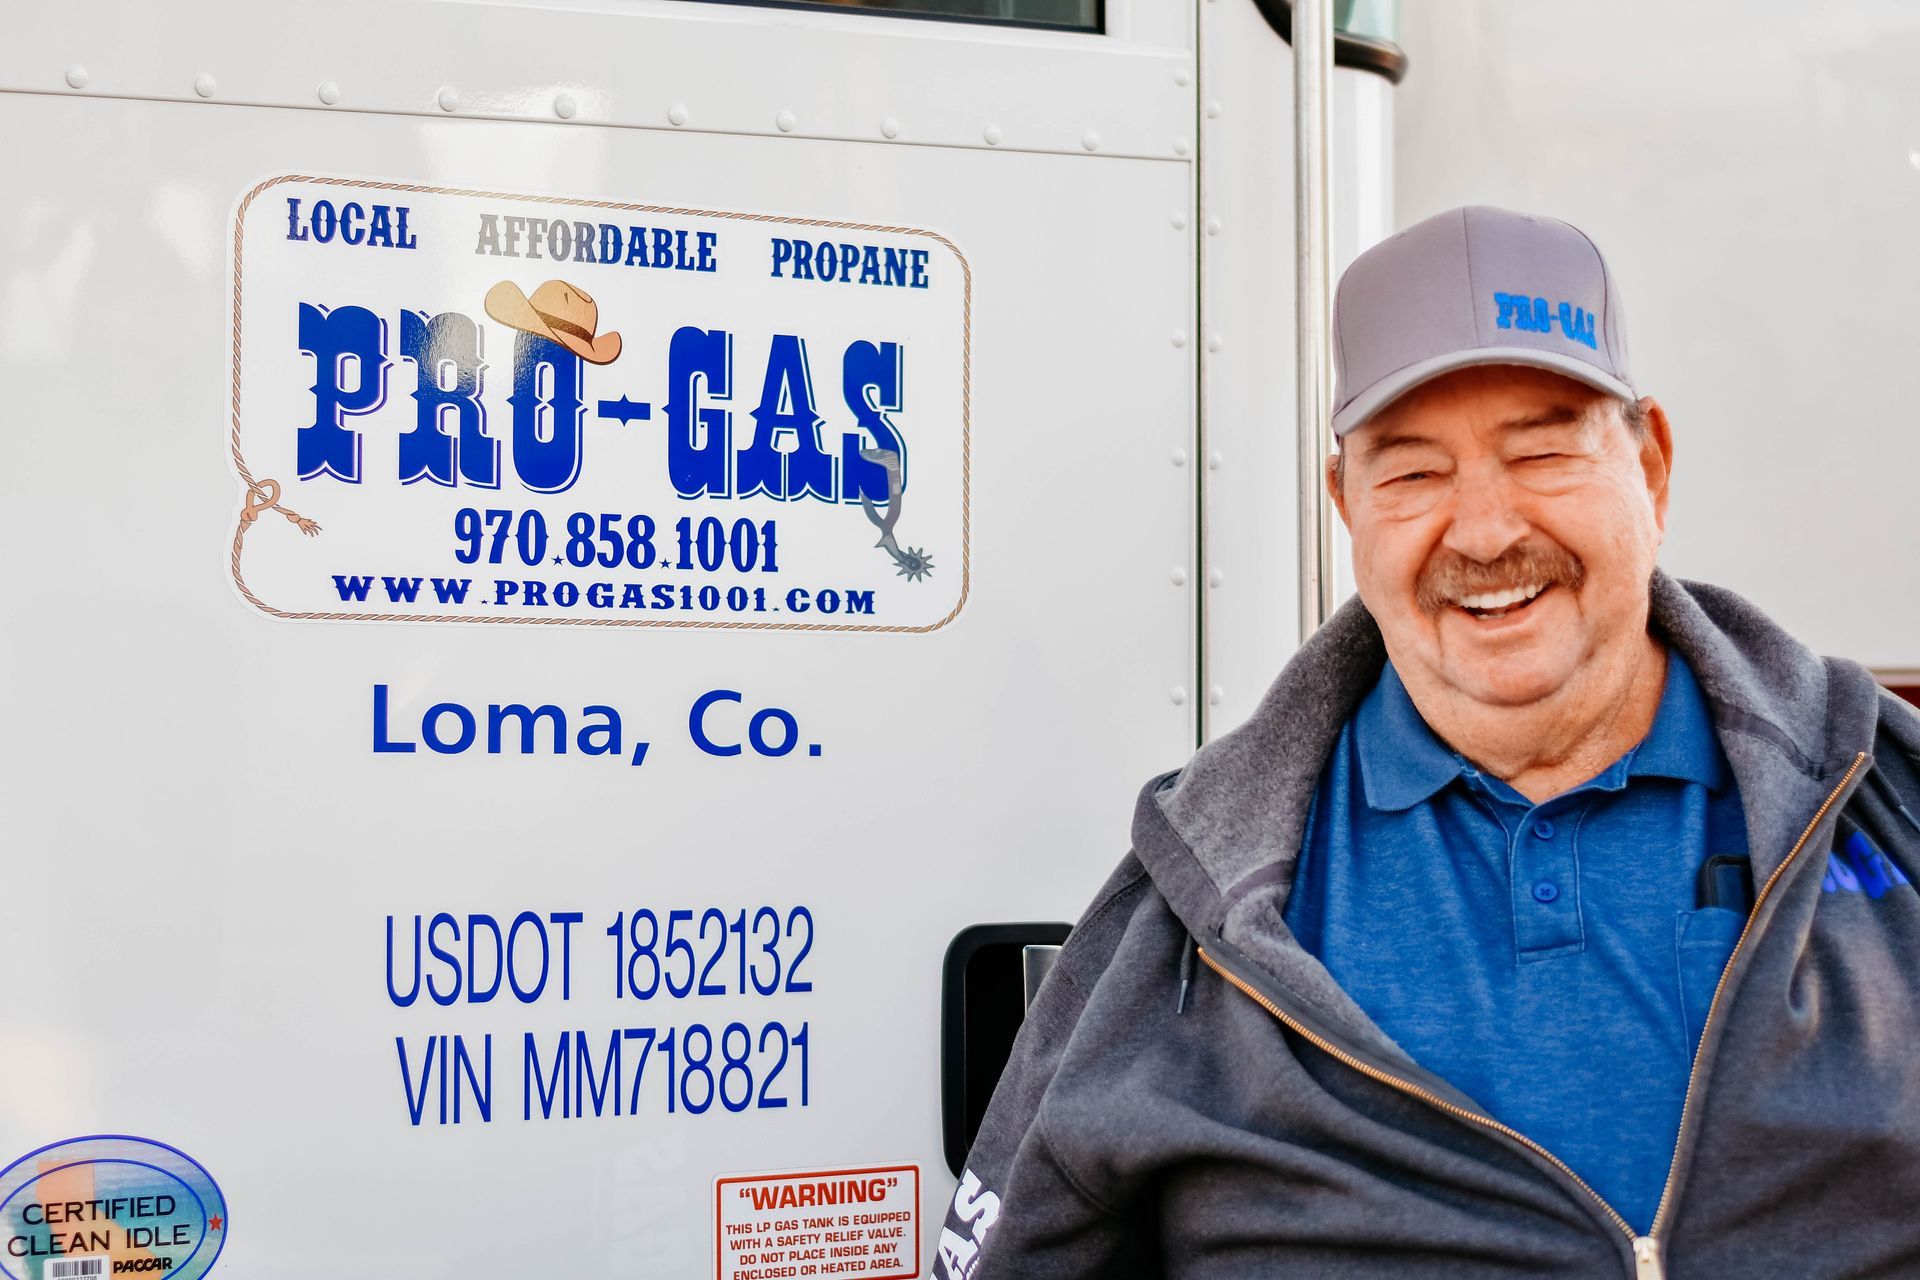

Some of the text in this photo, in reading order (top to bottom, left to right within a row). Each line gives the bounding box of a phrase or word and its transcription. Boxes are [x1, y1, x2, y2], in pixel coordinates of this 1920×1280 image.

[286, 197, 931, 289] LOCAL AFFORDABLE PROPANE
[297, 302, 909, 512] PRO-GAS
[372, 684, 823, 767] Loma, Co.
[385, 905, 815, 1008] USDOT 1852132
[395, 1020, 810, 1127] VIN MM718821
[22, 1194, 176, 1225] CERTIFIED
[726, 1211, 911, 1235] THIS LP GAS TANK IS EQUIPPED
[7, 1223, 191, 1257] CLEAN IDLE
[730, 1226, 907, 1251] WITH A SAFETY RELIEF VALVE.
[739, 1242, 898, 1266] DO NOT PLACE INSIDE ANY
[112, 1257, 173, 1274] PACCAR
[733, 1257, 904, 1280] ENCLOSED OR HEATED AREA.
